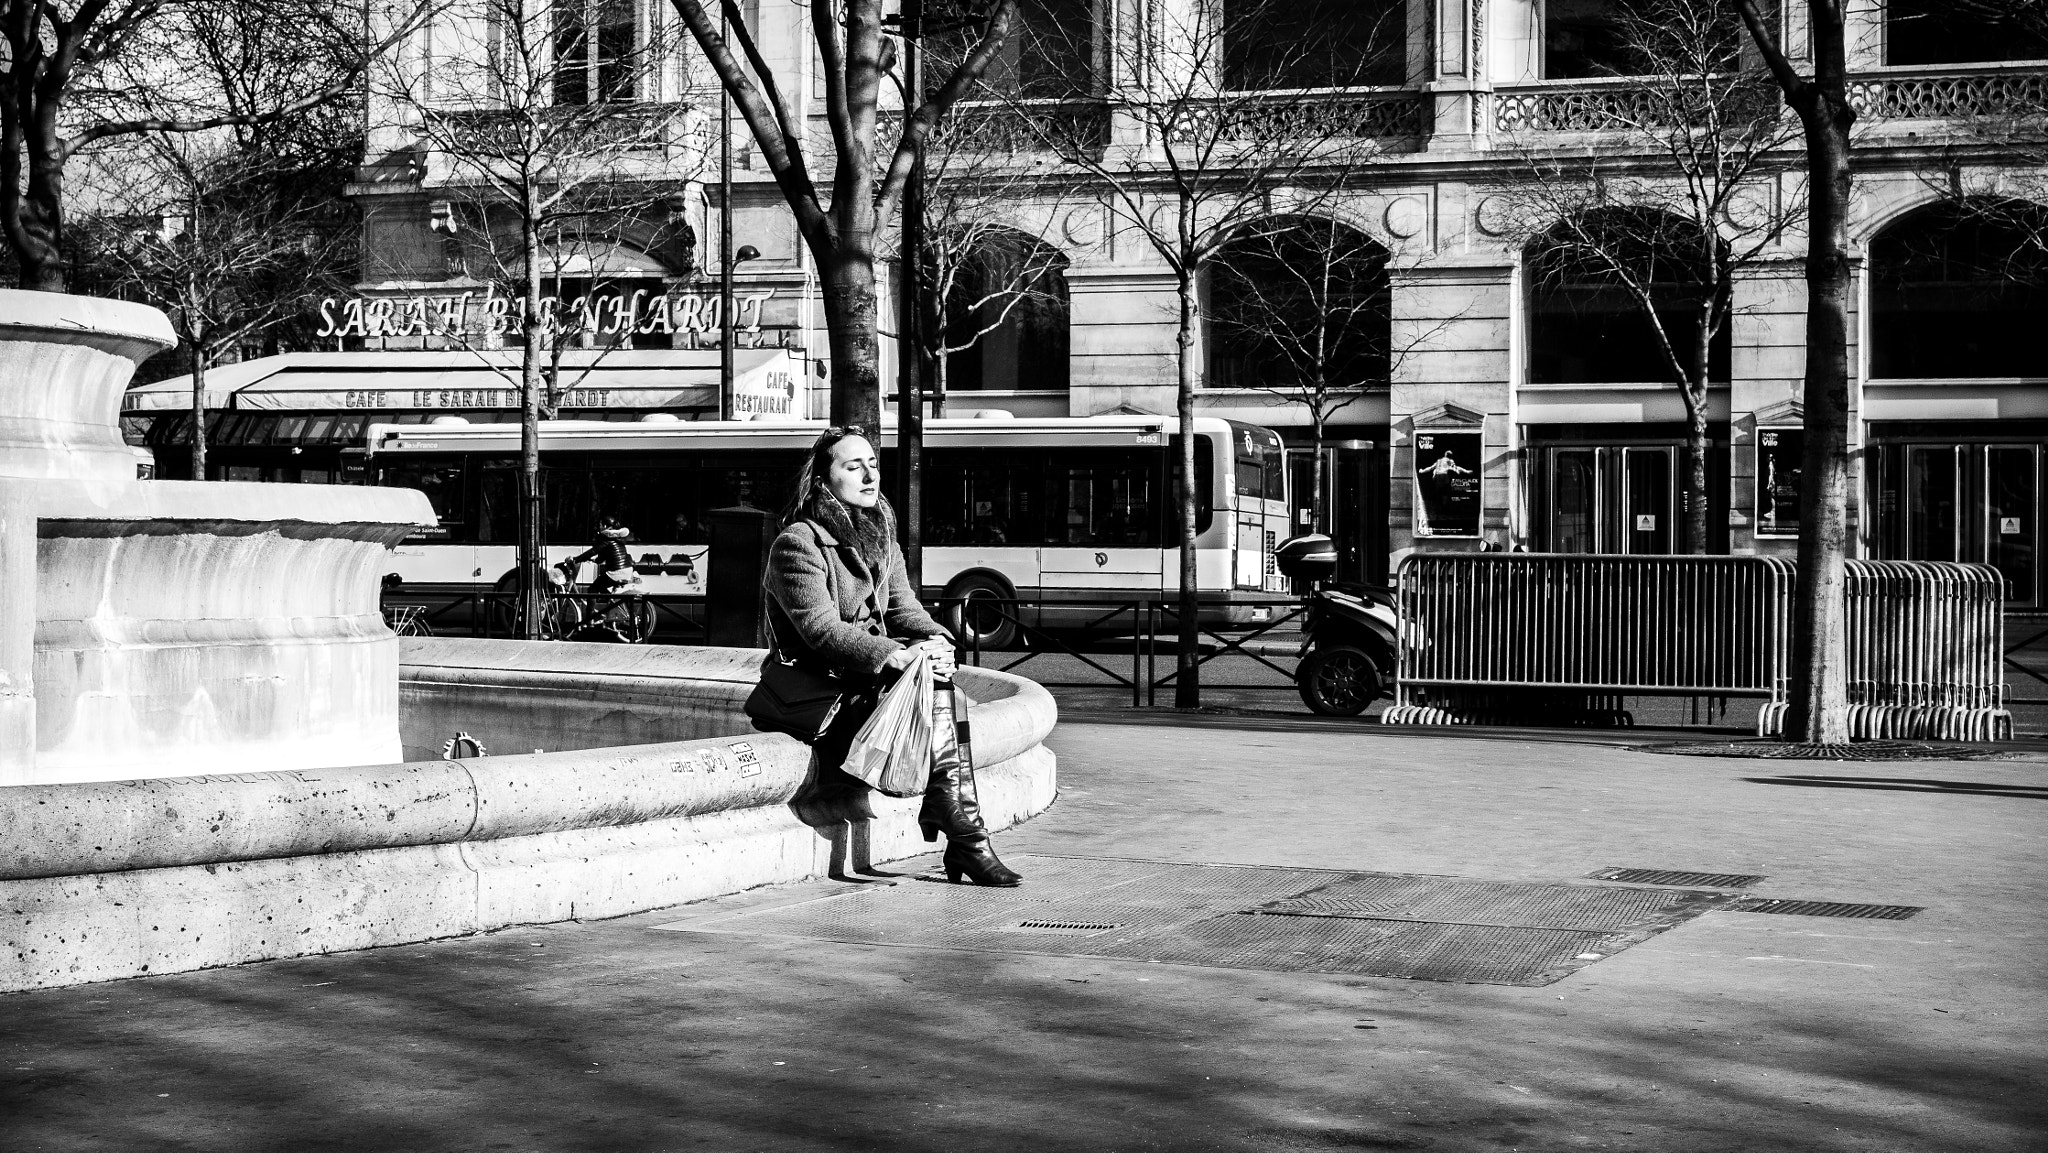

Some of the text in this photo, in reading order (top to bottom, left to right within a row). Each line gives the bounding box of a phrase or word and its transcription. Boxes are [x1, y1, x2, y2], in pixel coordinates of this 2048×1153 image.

[316, 290, 474, 337] SARAH
[766, 371, 788, 389] CAFE
[346, 390, 610, 407] CAFE LE SARAH BNARDT
[735, 393, 792, 414] RESTAURANT
[1136, 435, 1158, 444] 8493
